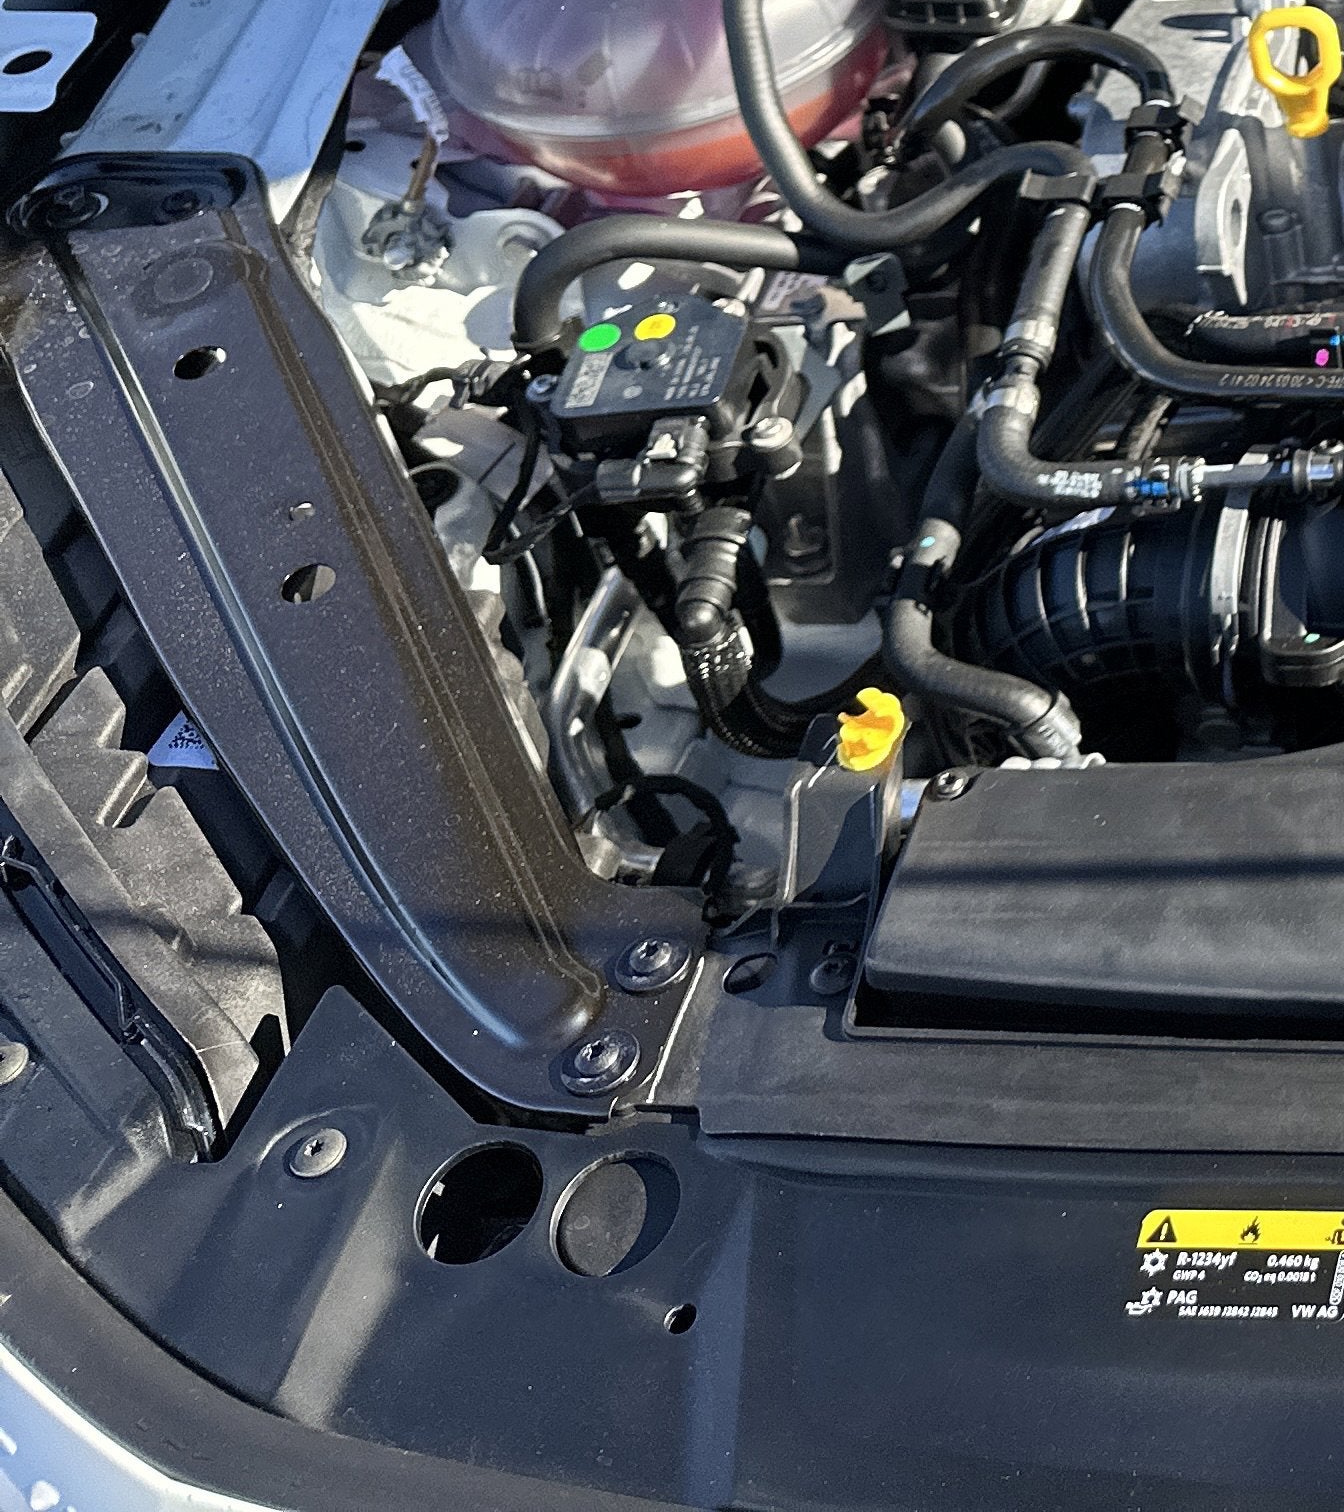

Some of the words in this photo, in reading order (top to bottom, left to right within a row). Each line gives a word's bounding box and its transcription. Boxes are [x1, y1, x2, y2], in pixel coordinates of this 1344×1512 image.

[1304, 1255, 1320, 1270] kg
[1166, 1290, 1198, 1305] PAG
[1178, 1305, 1197, 1317] SAE
[1291, 1305, 1314, 1318] VW
[1316, 1305, 1339, 1319] AG
